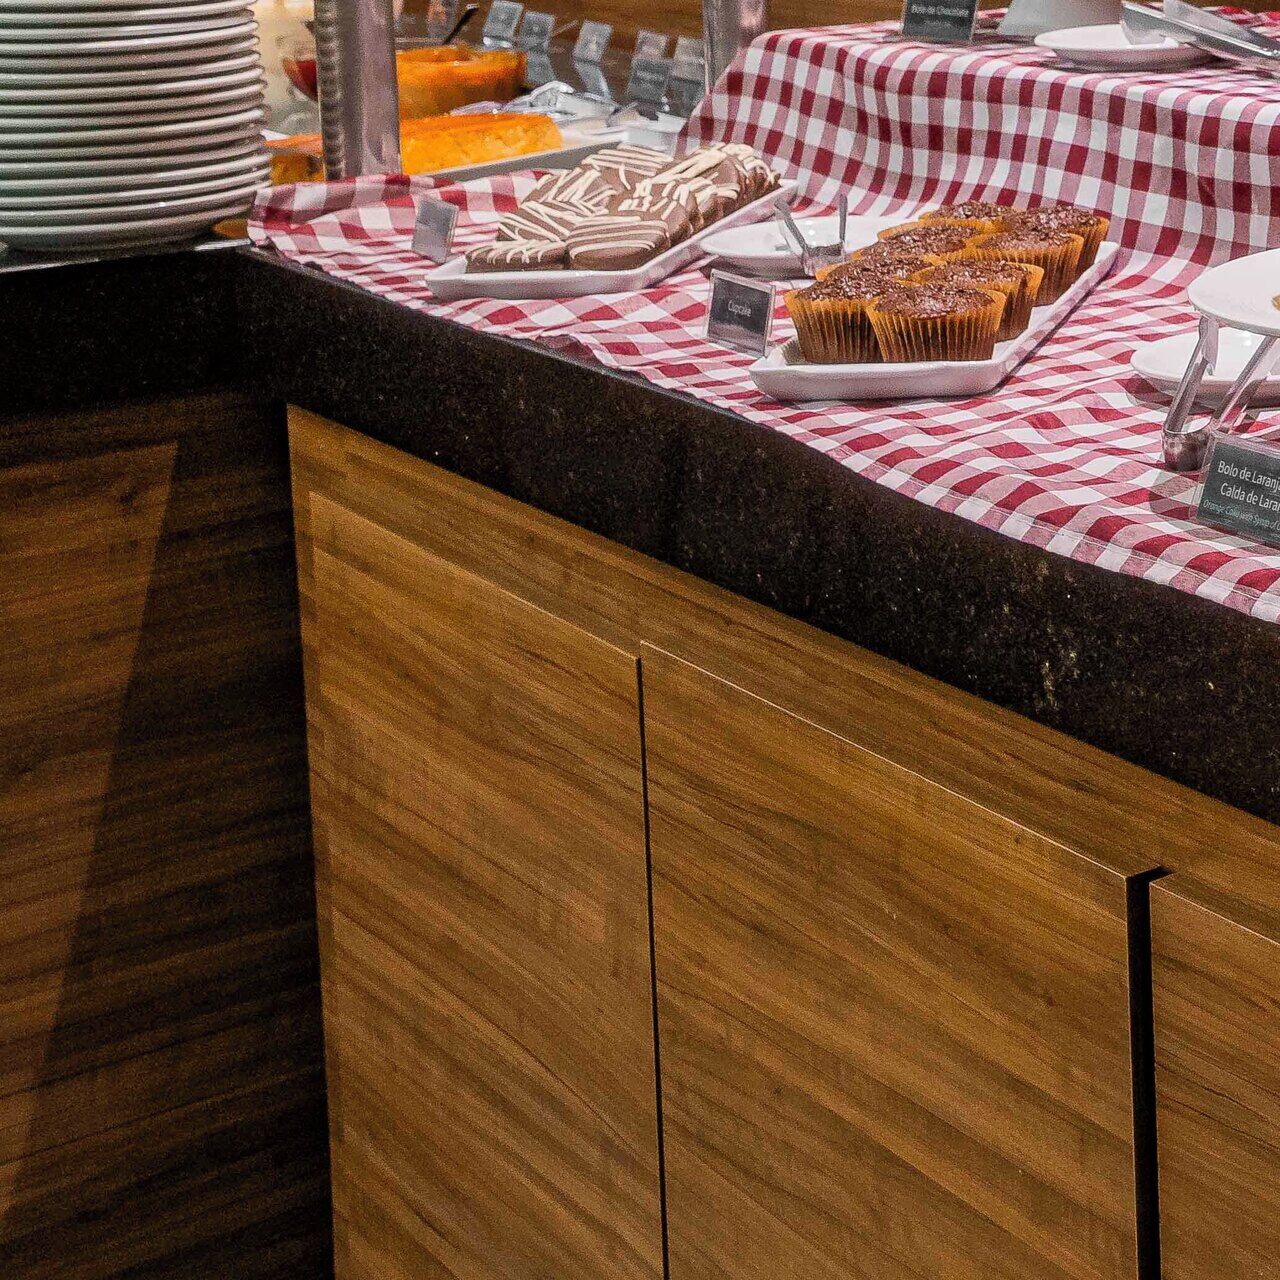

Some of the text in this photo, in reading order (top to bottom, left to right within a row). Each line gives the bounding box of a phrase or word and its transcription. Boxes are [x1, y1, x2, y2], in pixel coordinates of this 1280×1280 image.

[1217, 460, 1239, 478] Bolo
[1239, 467, 1251, 482] de
[1220, 482, 1245, 501] Calda
[1246, 490, 1258, 505] de
